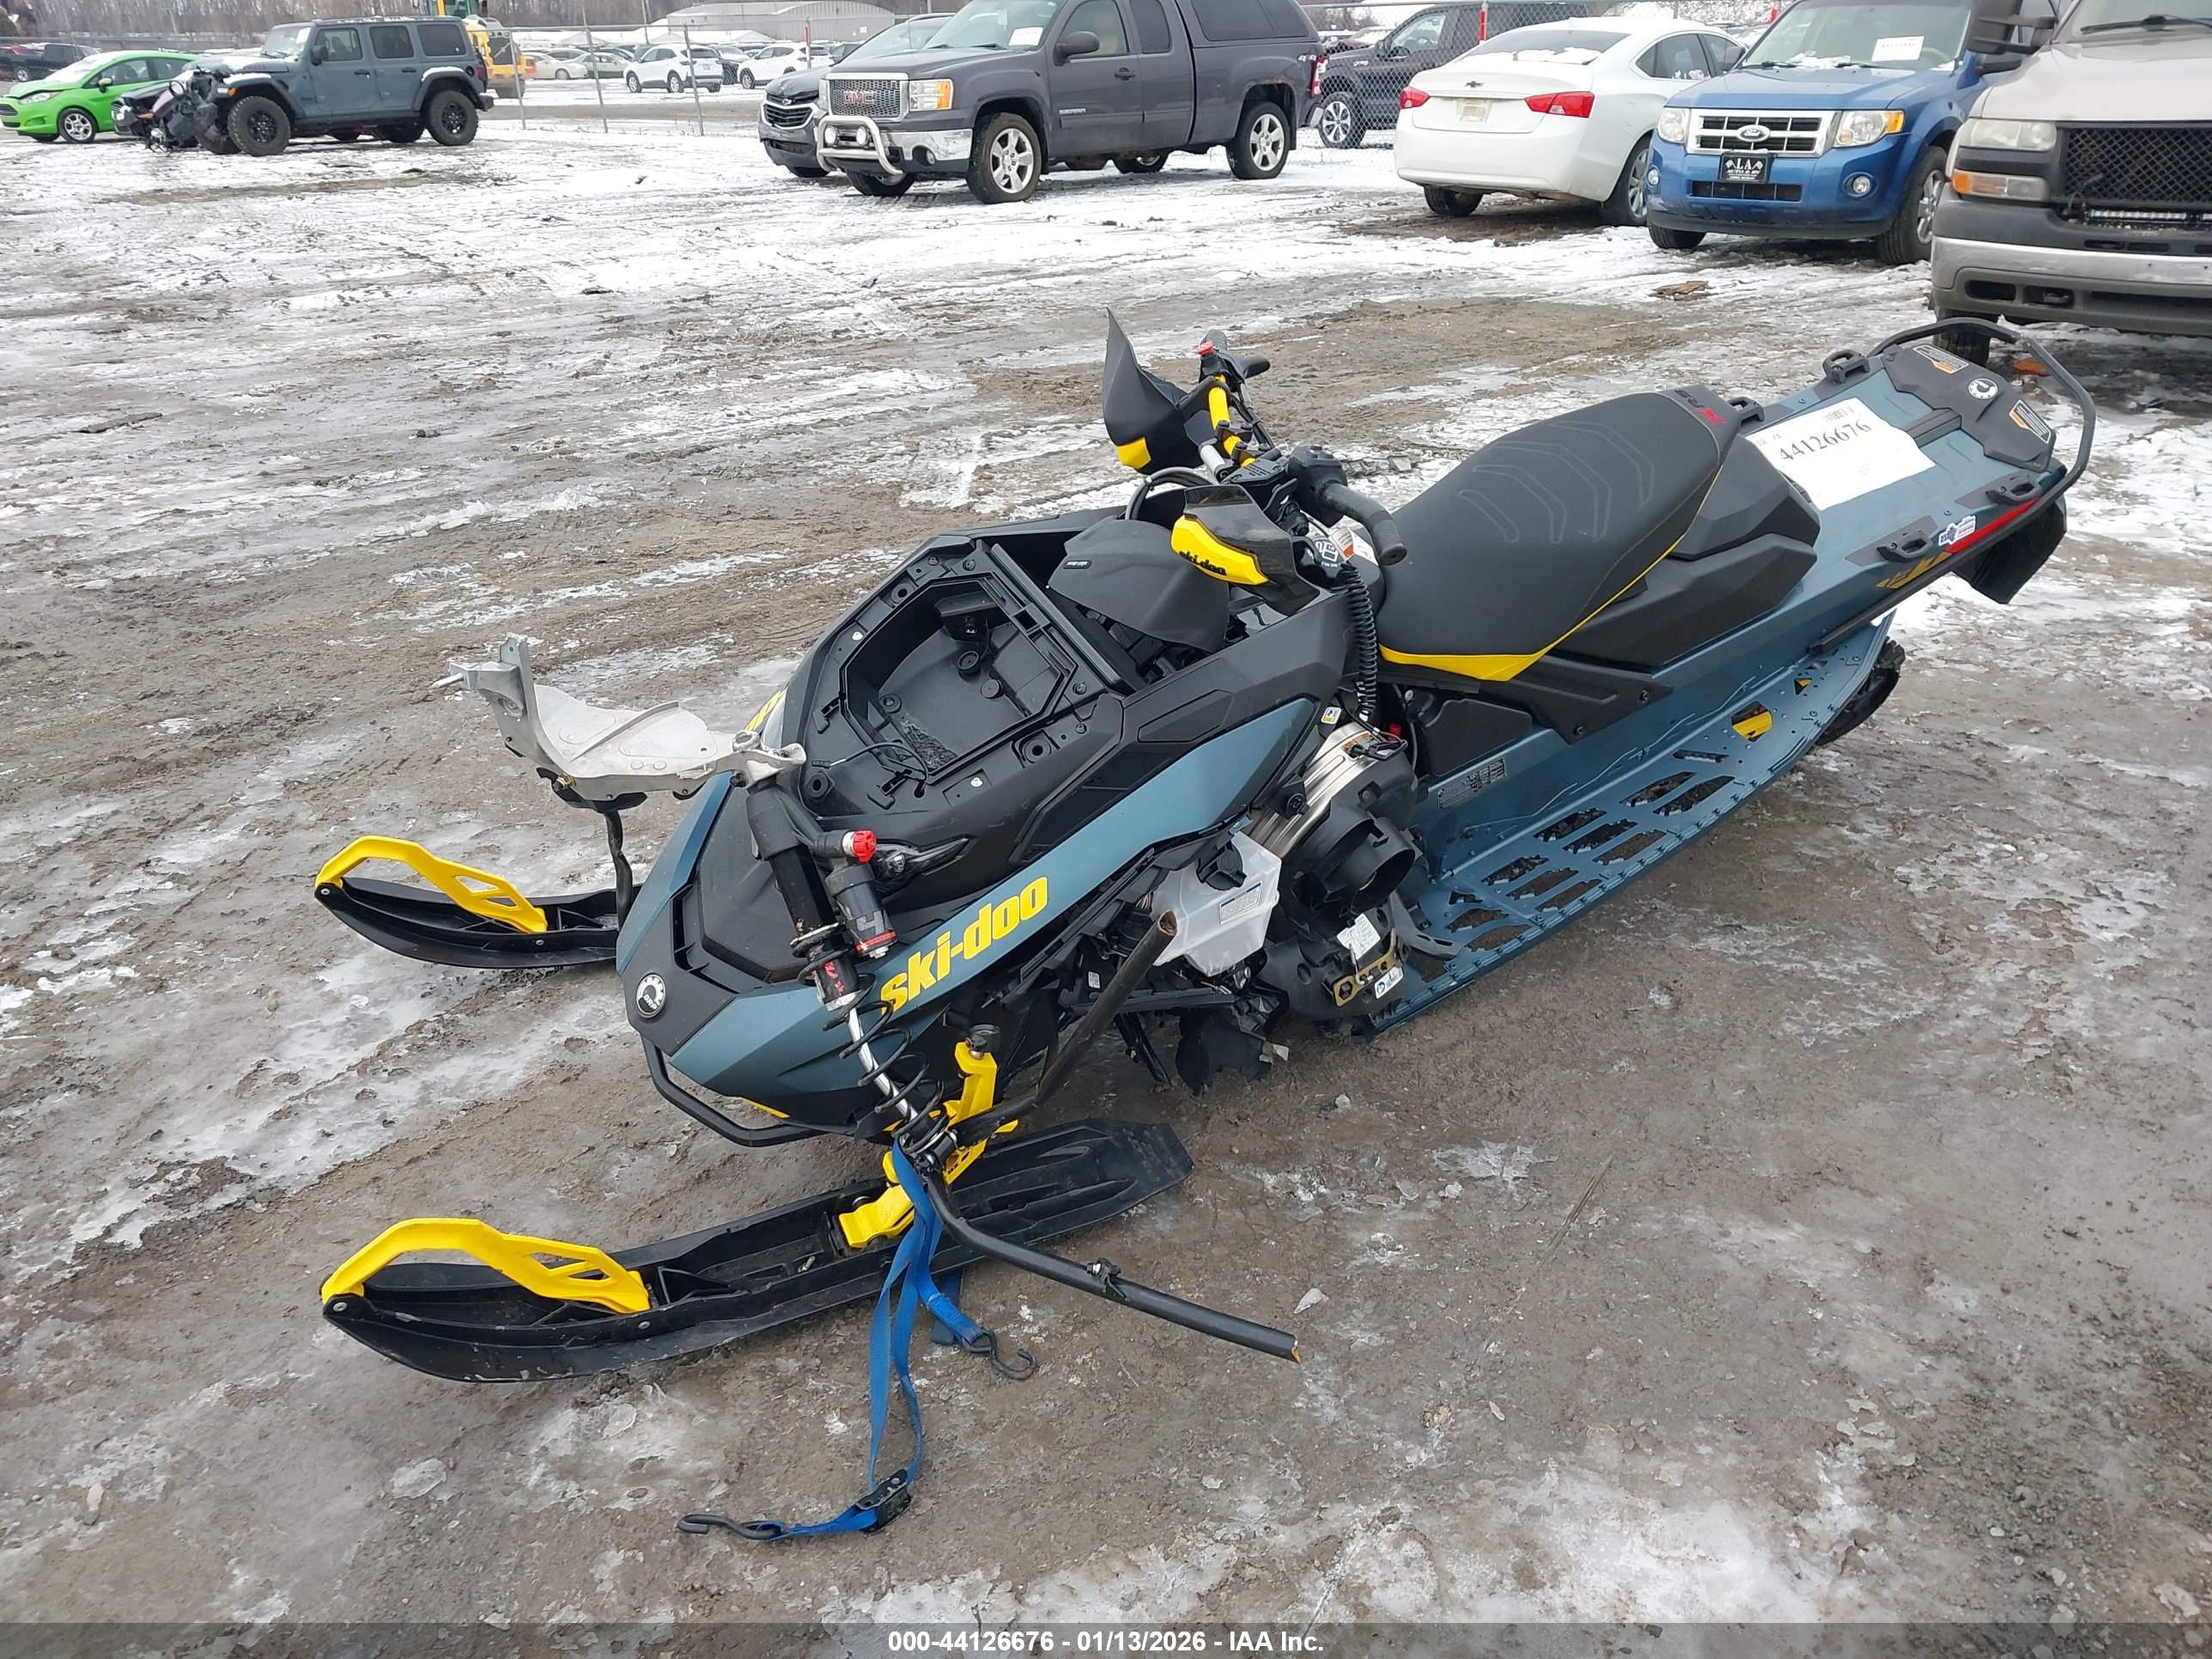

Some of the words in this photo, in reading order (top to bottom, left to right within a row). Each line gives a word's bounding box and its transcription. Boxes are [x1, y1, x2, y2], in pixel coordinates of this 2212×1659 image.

[843, 90, 875, 104] GMC
[1778, 418, 1872, 461] 44126676
[880, 876, 1048, 1016] ski-doo
